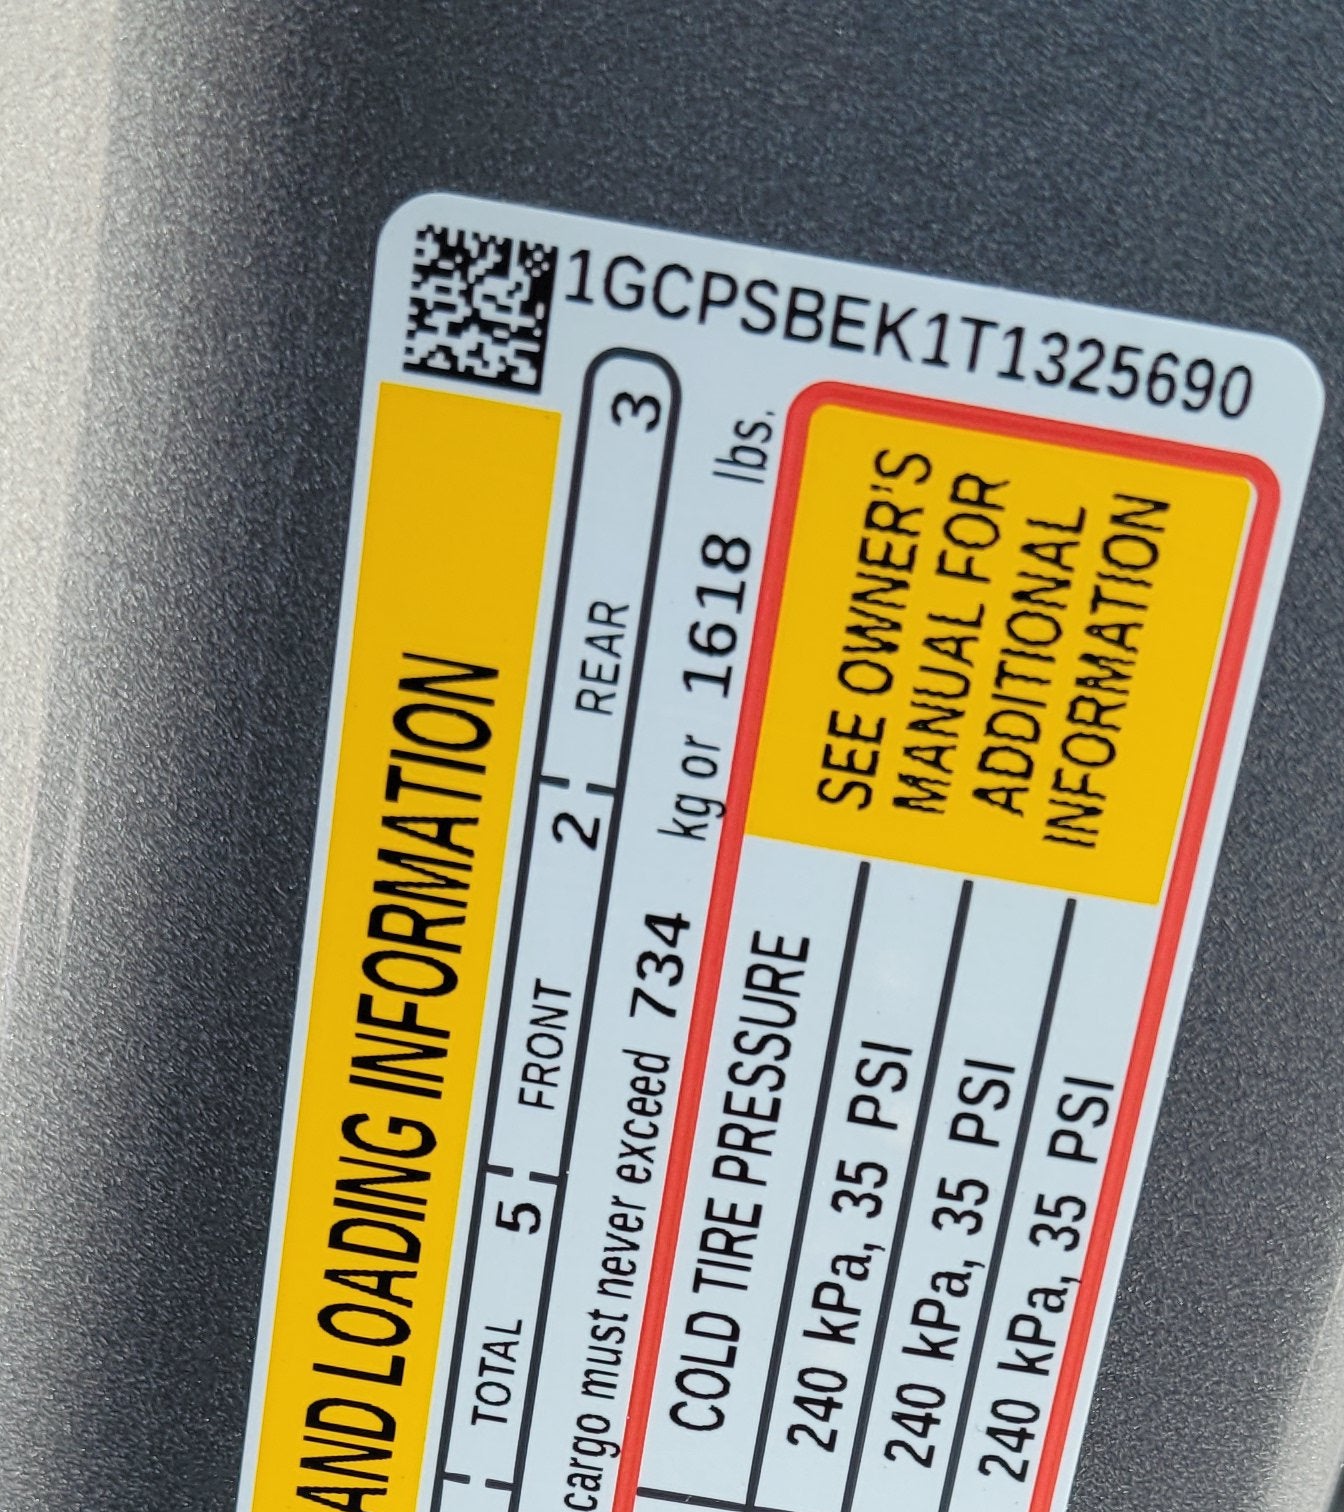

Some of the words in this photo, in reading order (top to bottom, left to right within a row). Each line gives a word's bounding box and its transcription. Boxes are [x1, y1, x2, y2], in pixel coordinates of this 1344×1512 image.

[565, 248, 1253, 419] 1GCPSBEK1T1325690
[610, 391, 662, 432] 3
[712, 411, 775, 484] lbs.
[837, 449, 933, 696] OWNER'S
[935, 472, 1010, 584] FOR
[575, 601, 630, 716] REAR
[682, 533, 752, 698] 1618
[971, 506, 1086, 817] ADDITIONAL
[892, 603, 986, 814] MANUAL
[1043, 493, 1171, 849] INFORMATION
[680, 734, 721, 779] or
[816, 710, 887, 811] SEE
[551, 811, 601, 851] 2
[657, 793, 724, 841] kg
[348, 652, 500, 1100] INFORMATION
[629, 912, 691, 1018] 734
[517, 977, 572, 1110] FRONT
[711, 930, 811, 1187] PRESSURE
[846, 1040, 913, 1131] PSI
[615, 1048, 671, 1185] exceed
[948, 1058, 1016, 1148] PSI
[1046, 1076, 1115, 1164] PSI
[495, 1200, 542, 1235] 5
[830, 1159, 889, 1219] 35
[931, 1177, 990, 1236] 35
[1028, 1193, 1087, 1252] 35
[312, 1113, 438, 1387] LOADING
[596, 1195, 647, 1300] never
[692, 1197, 763, 1294] TIRE
[802, 1243, 886, 1345] kPa,
[580, 1308, 629, 1400] must
[901, 1259, 986, 1362] kPa,
[996, 1276, 1082, 1377] kPa,
[470, 1319, 523, 1426] TOTAL
[668, 1310, 741, 1432] COLD
[786, 1366, 848, 1453] 240
[563, 1413, 621, 1512] cargo
[883, 1382, 946, 1469] 240
[977, 1398, 1041, 1483] 240
